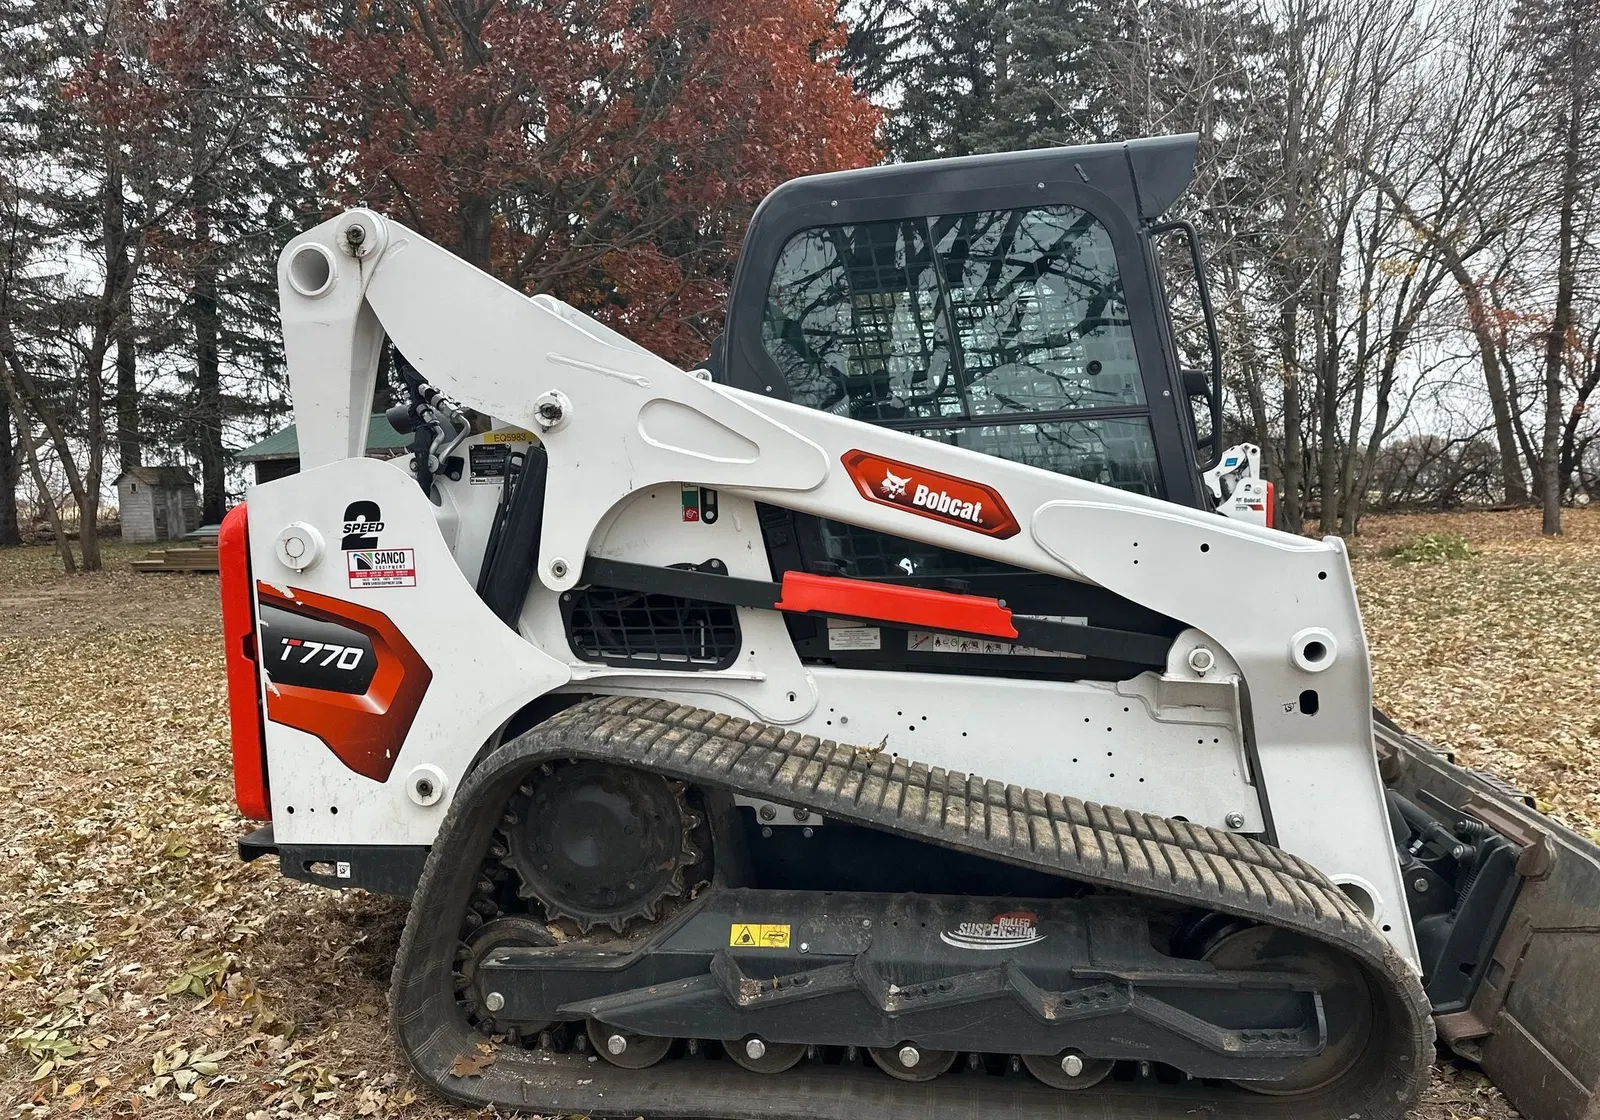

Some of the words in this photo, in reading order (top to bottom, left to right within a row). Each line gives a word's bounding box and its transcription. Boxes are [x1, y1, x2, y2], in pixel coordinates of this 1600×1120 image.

[494, 433, 526, 442] EQ5983
[912, 484, 982, 523] Bobcat
[341, 500, 381, 550] 2
[343, 522, 385, 534] SPEED
[374, 551, 405, 565] SANCO
[280, 638, 364, 671] T770
[999, 917, 1031, 927] ROLLER
[958, 922, 1037, 938] SUSPENSION
